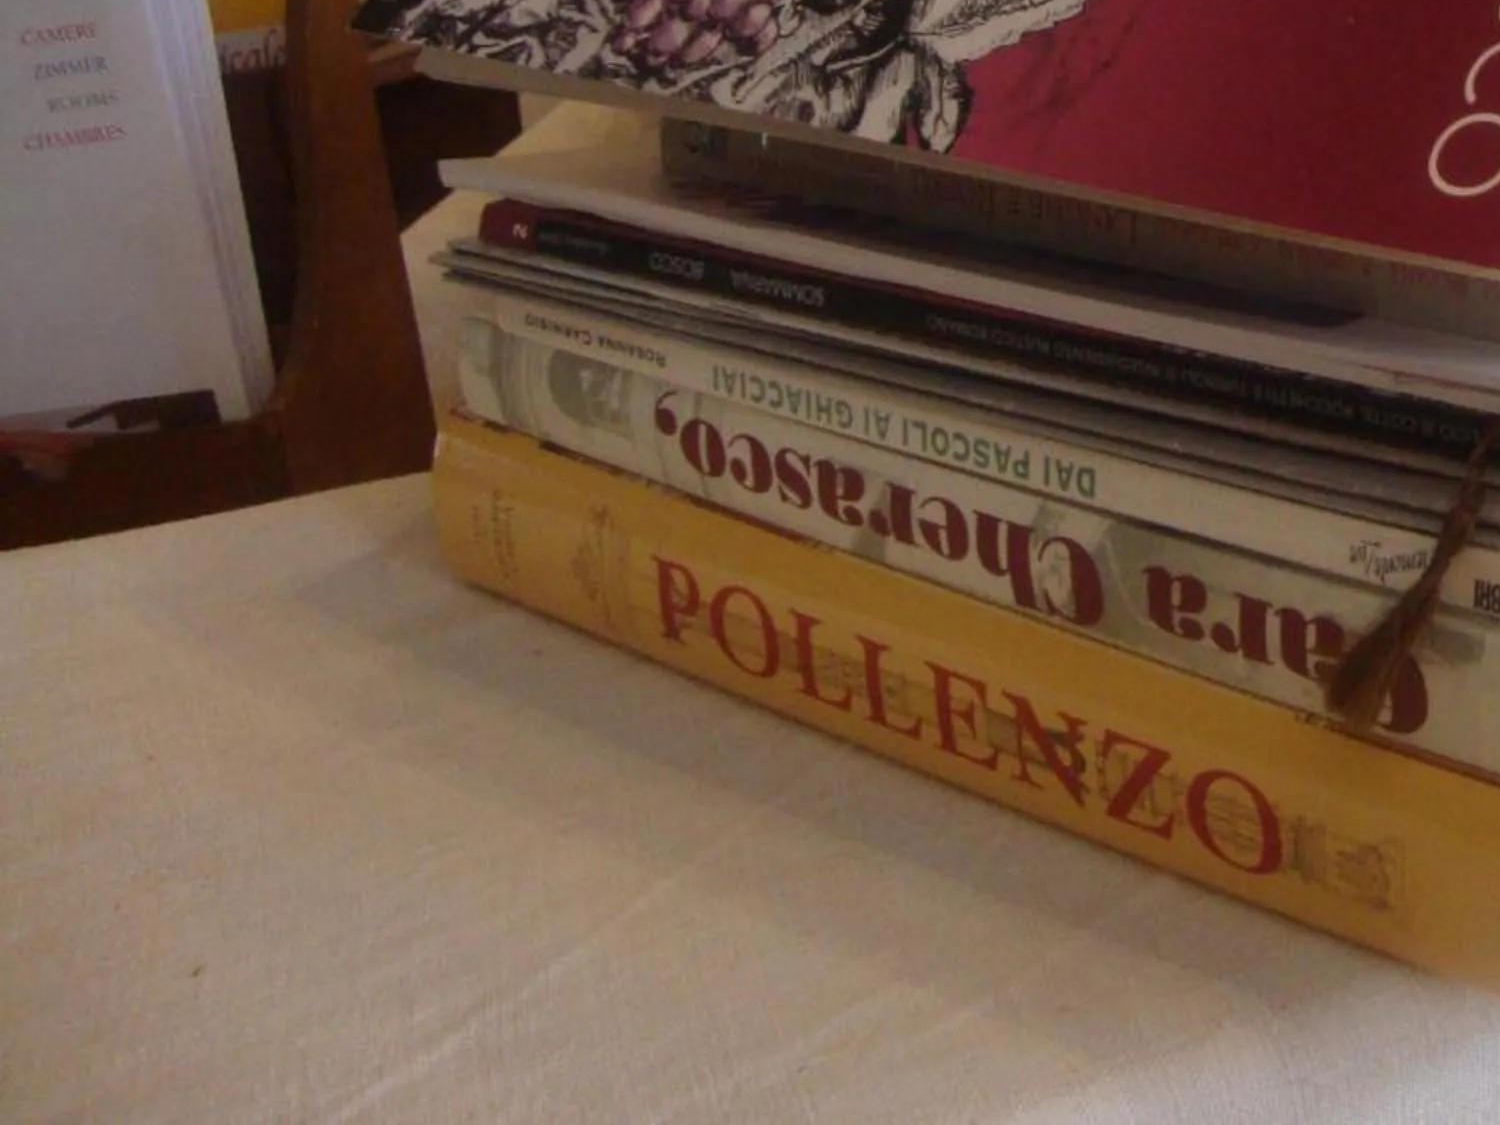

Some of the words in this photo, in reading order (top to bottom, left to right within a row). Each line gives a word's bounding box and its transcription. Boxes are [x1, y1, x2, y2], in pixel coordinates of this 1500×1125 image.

[20, 23, 98, 46] CAMERE
[35, 56, 109, 81] ZIMMER
[46, 89, 121, 114] ROOMS
[23, 124, 128, 152] CHAMBRES
[647, 250, 706, 279] BOSCO
[728, 268, 826, 307] SOMMARIVA
[709, 365, 855, 431] GHIACCIAI
[862, 411, 893, 440] AI
[901, 419, 1031, 480] PASCOLI
[1043, 457, 1097, 498] DAI
[653, 389, 1105, 628] Cherasco,
[650, 554, 1285, 875] POLLENZO
